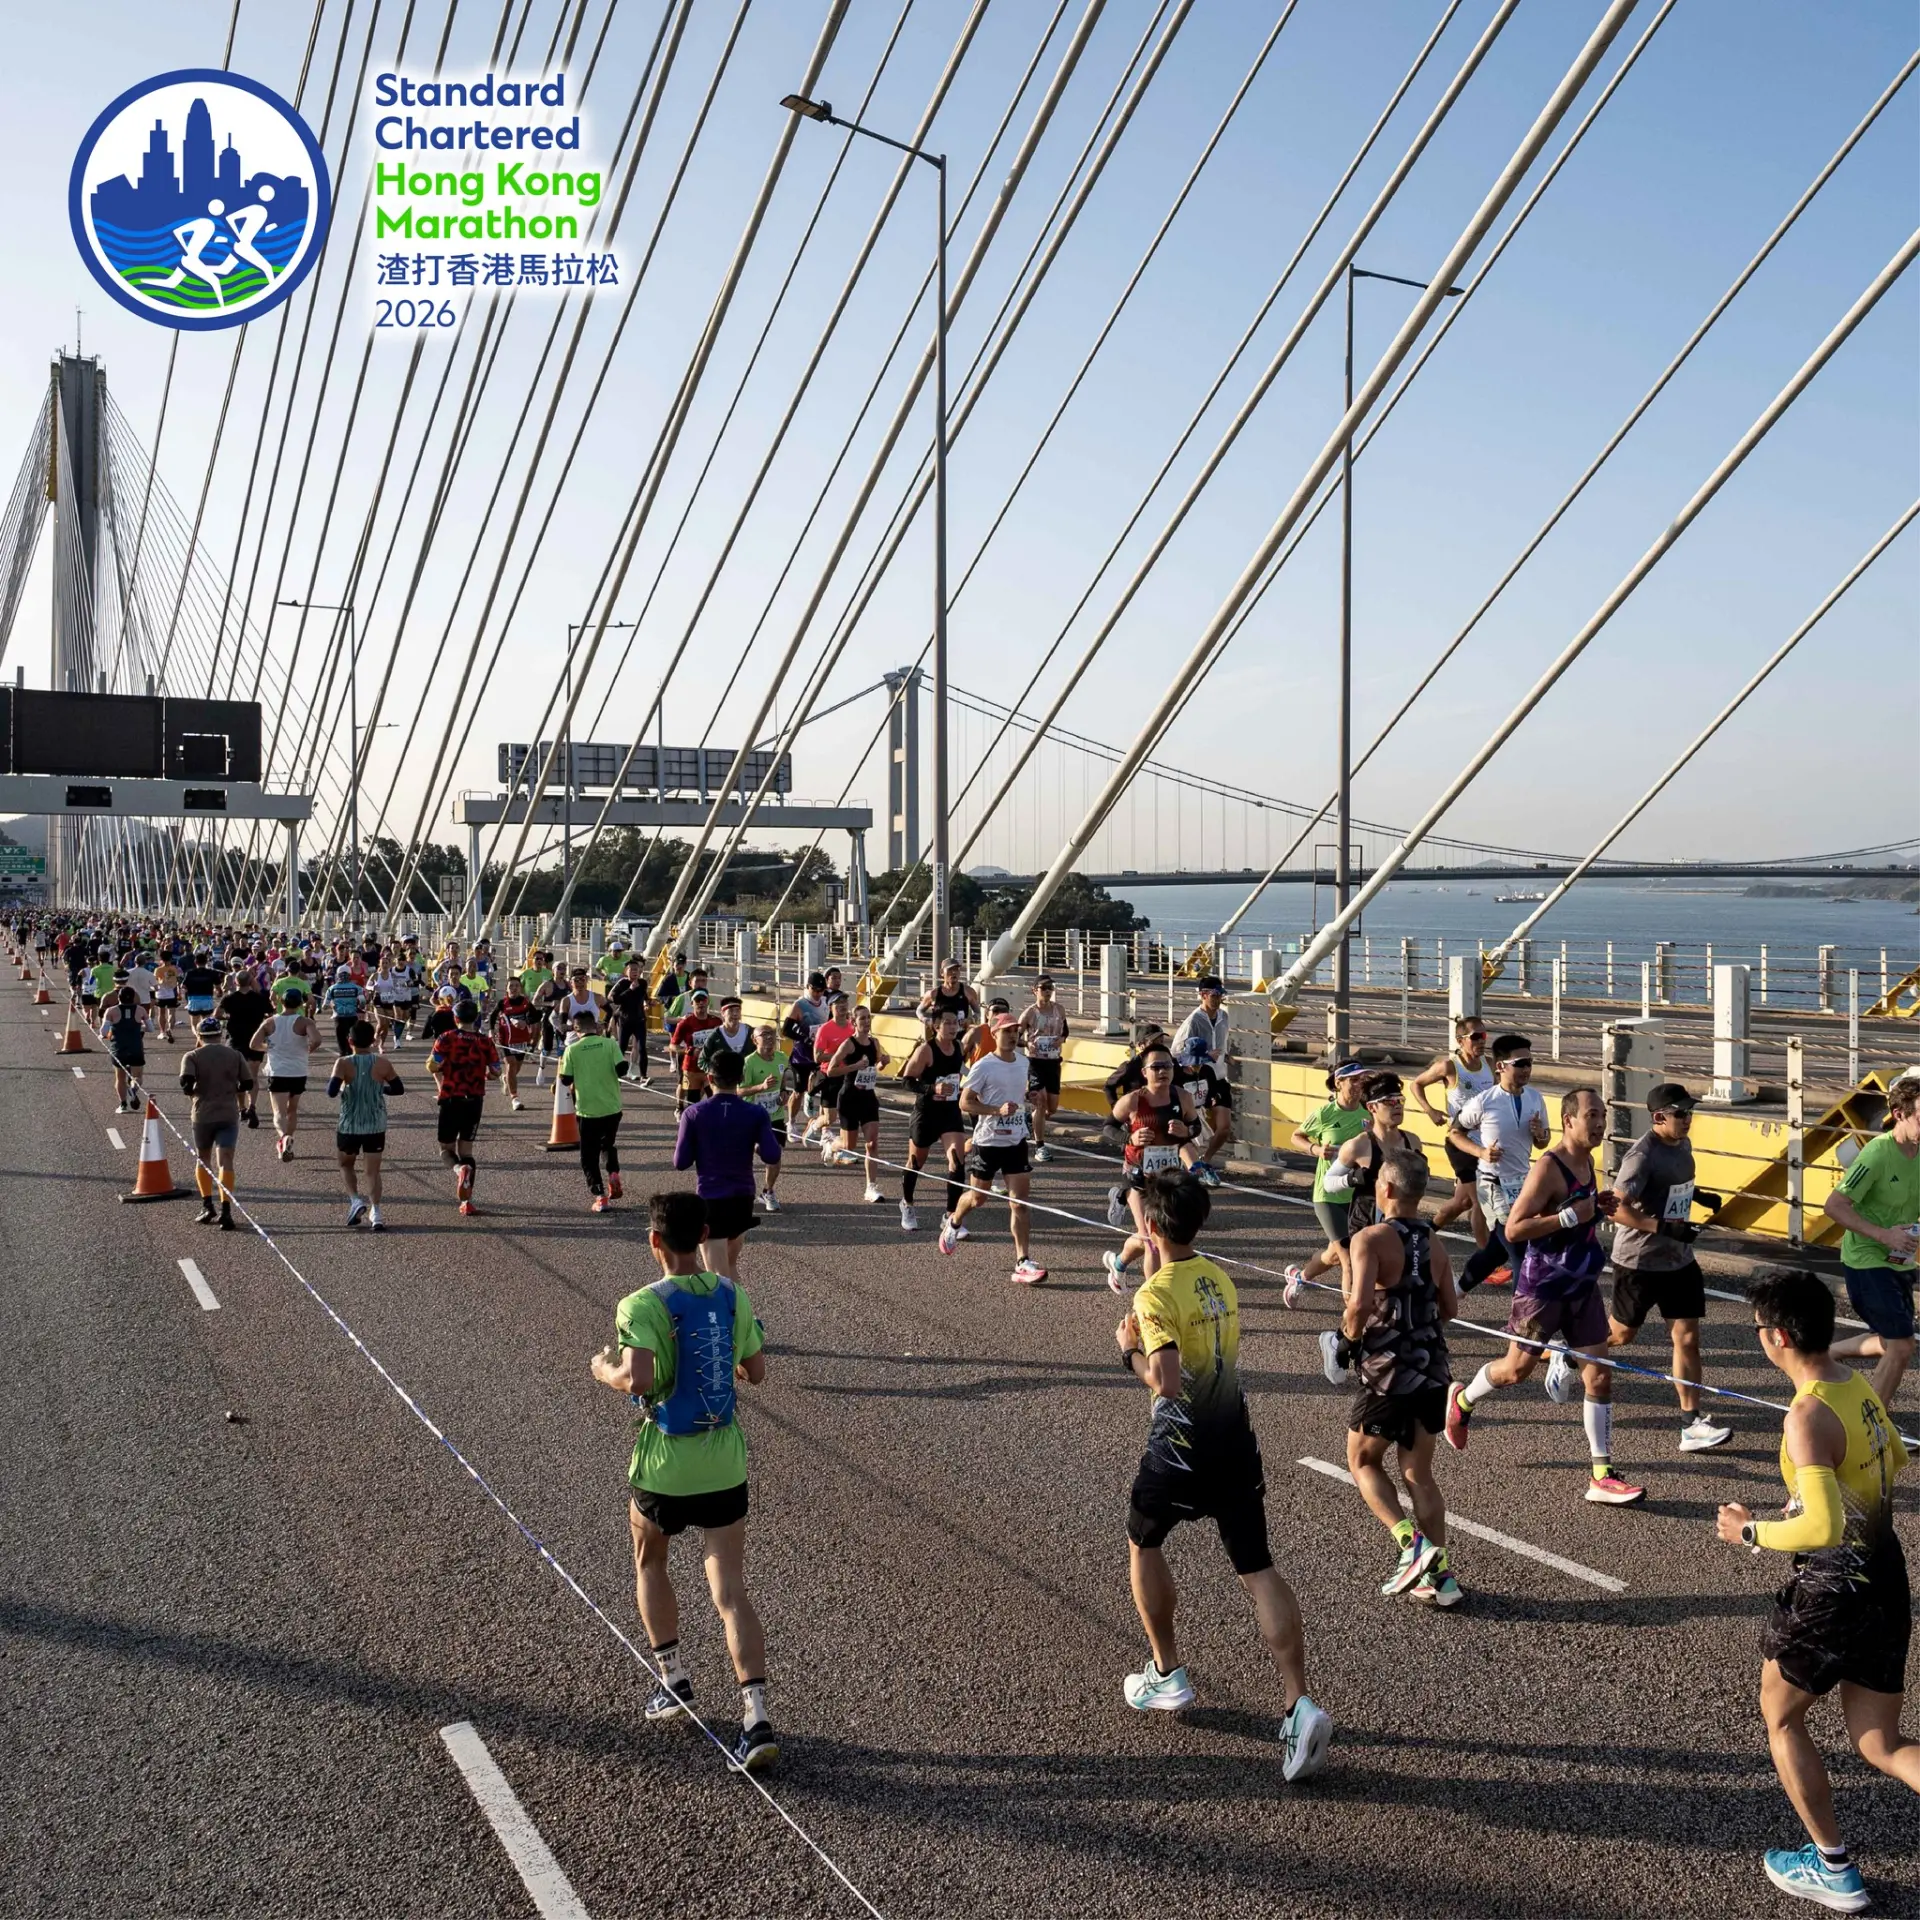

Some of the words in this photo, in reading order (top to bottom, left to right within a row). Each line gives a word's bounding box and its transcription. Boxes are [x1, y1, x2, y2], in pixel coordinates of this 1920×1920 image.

[996, 1115, 1023, 1127] A4455
[1412, 1233, 1420, 1248] Dr.
[1411, 1250, 1420, 1276] Kong
